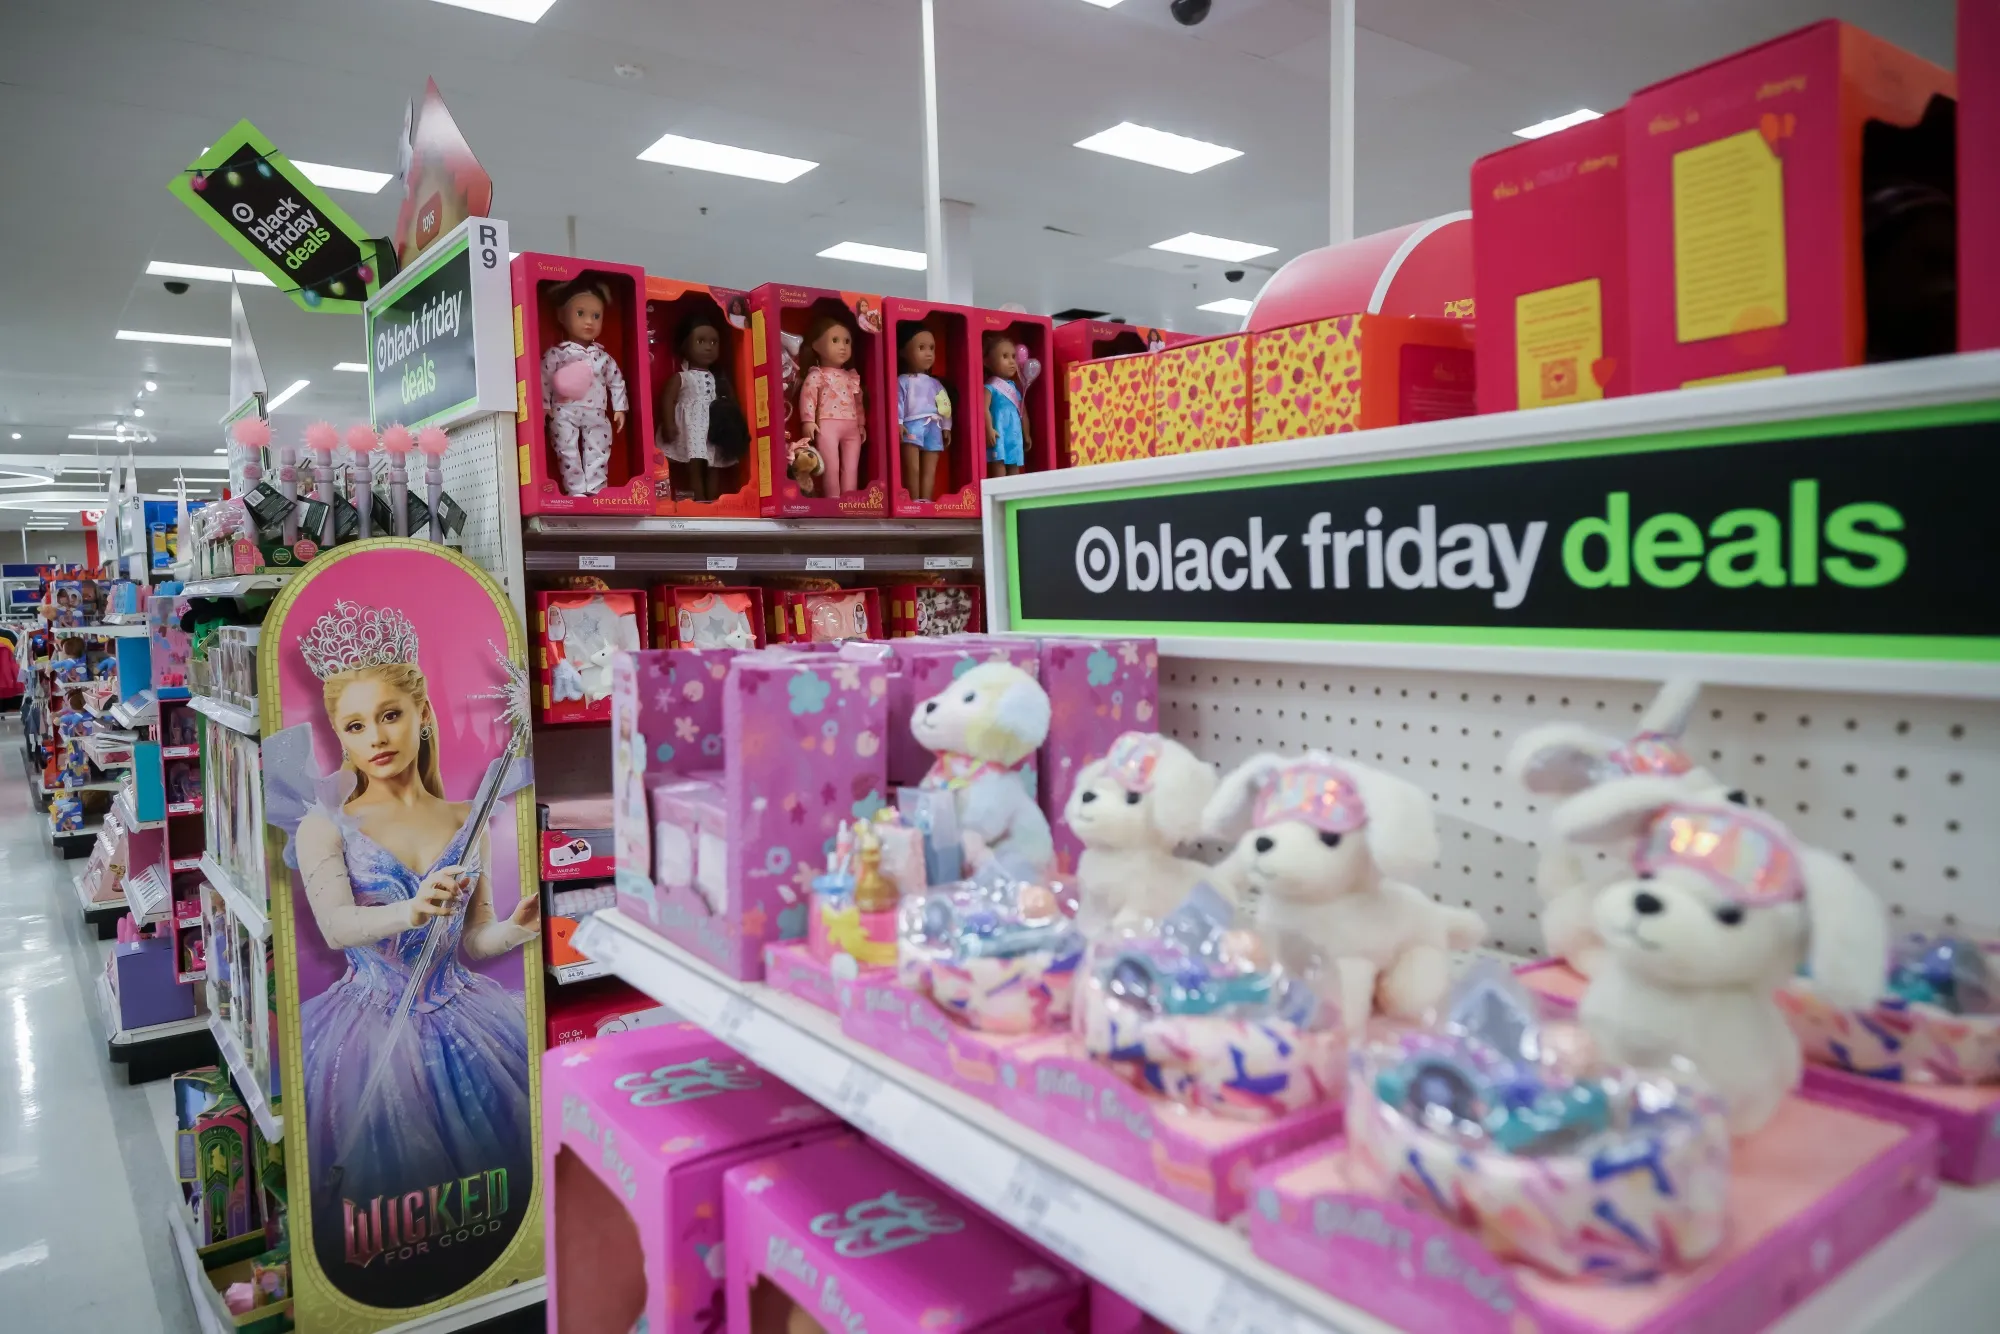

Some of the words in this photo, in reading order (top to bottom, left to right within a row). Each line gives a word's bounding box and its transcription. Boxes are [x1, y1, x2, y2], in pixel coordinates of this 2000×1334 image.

[248, 196, 301, 242] black
[266, 209, 319, 256] friday
[285, 227, 331, 270] deals
[537, 261, 568, 275] Serenity
[387, 311, 419, 367] black
[421, 290, 463, 346] friday
[401, 353, 436, 405] deals
[1124, 515, 1292, 593] black
[1301, 504, 1549, 610] friday
[1561, 479, 1909, 590] deals
[342, 1167, 508, 1268] WICKED
[384, 1241, 430, 1266] FOR
[438, 1219, 502, 1247] GOOD
